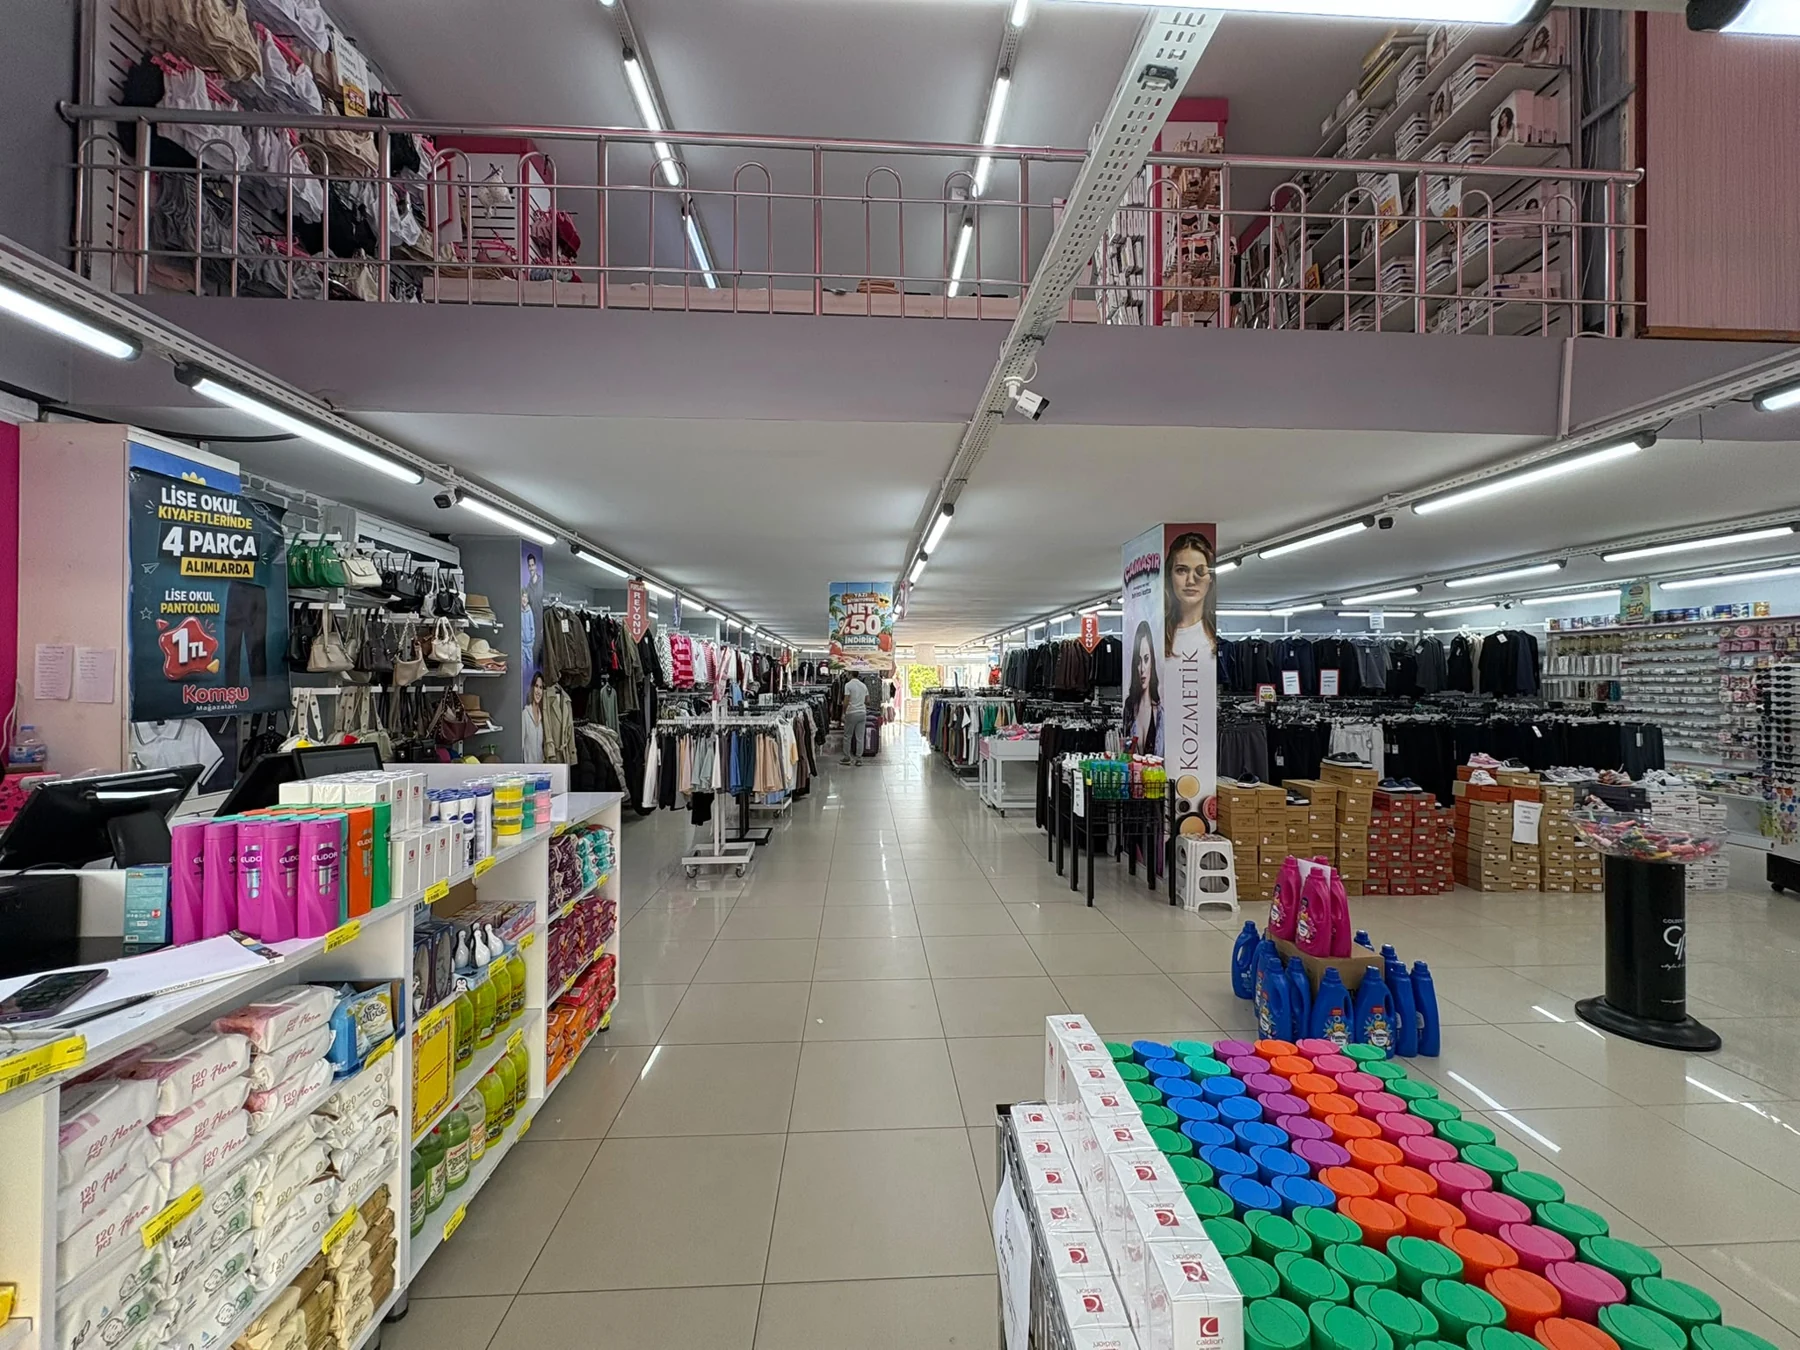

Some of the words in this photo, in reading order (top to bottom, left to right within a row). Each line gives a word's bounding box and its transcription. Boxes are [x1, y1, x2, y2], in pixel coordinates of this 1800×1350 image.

[161, 485, 197, 508] LİSE
[201, 494, 242, 515] OKUL
[158, 505, 253, 530] KIYAFETLERİNDE
[162, 526, 184, 556] 4
[189, 530, 257, 559] PARÇA
[185, 560, 251, 575] ALIMLARDA
[165, 588, 187, 601] LİSE
[189, 591, 215, 602] OKUL
[160, 603, 220, 614] PANTOLONU
[632, 591, 641, 635] REYONU
[847, 603, 874, 615] NET
[838, 614, 881, 636] %50
[844, 635, 876, 645] İNDİRİM
[182, 684, 249, 704] Komşu
[196, 704, 238, 712] Mağazaları
[1179, 648, 1199, 770] KOZMETİK
[240, 855, 262, 863] ELiDO
[191, 1068, 208, 1084] 120
[210, 1061, 238, 1081] Flora
[203, 1147, 218, 1165] 120
[80, 1181, 98, 1203] 120
[95, 1223, 115, 1247] 120
[1092, 1340, 1121, 1348] caldion
[1196, 1336, 1224, 1345] caldion
